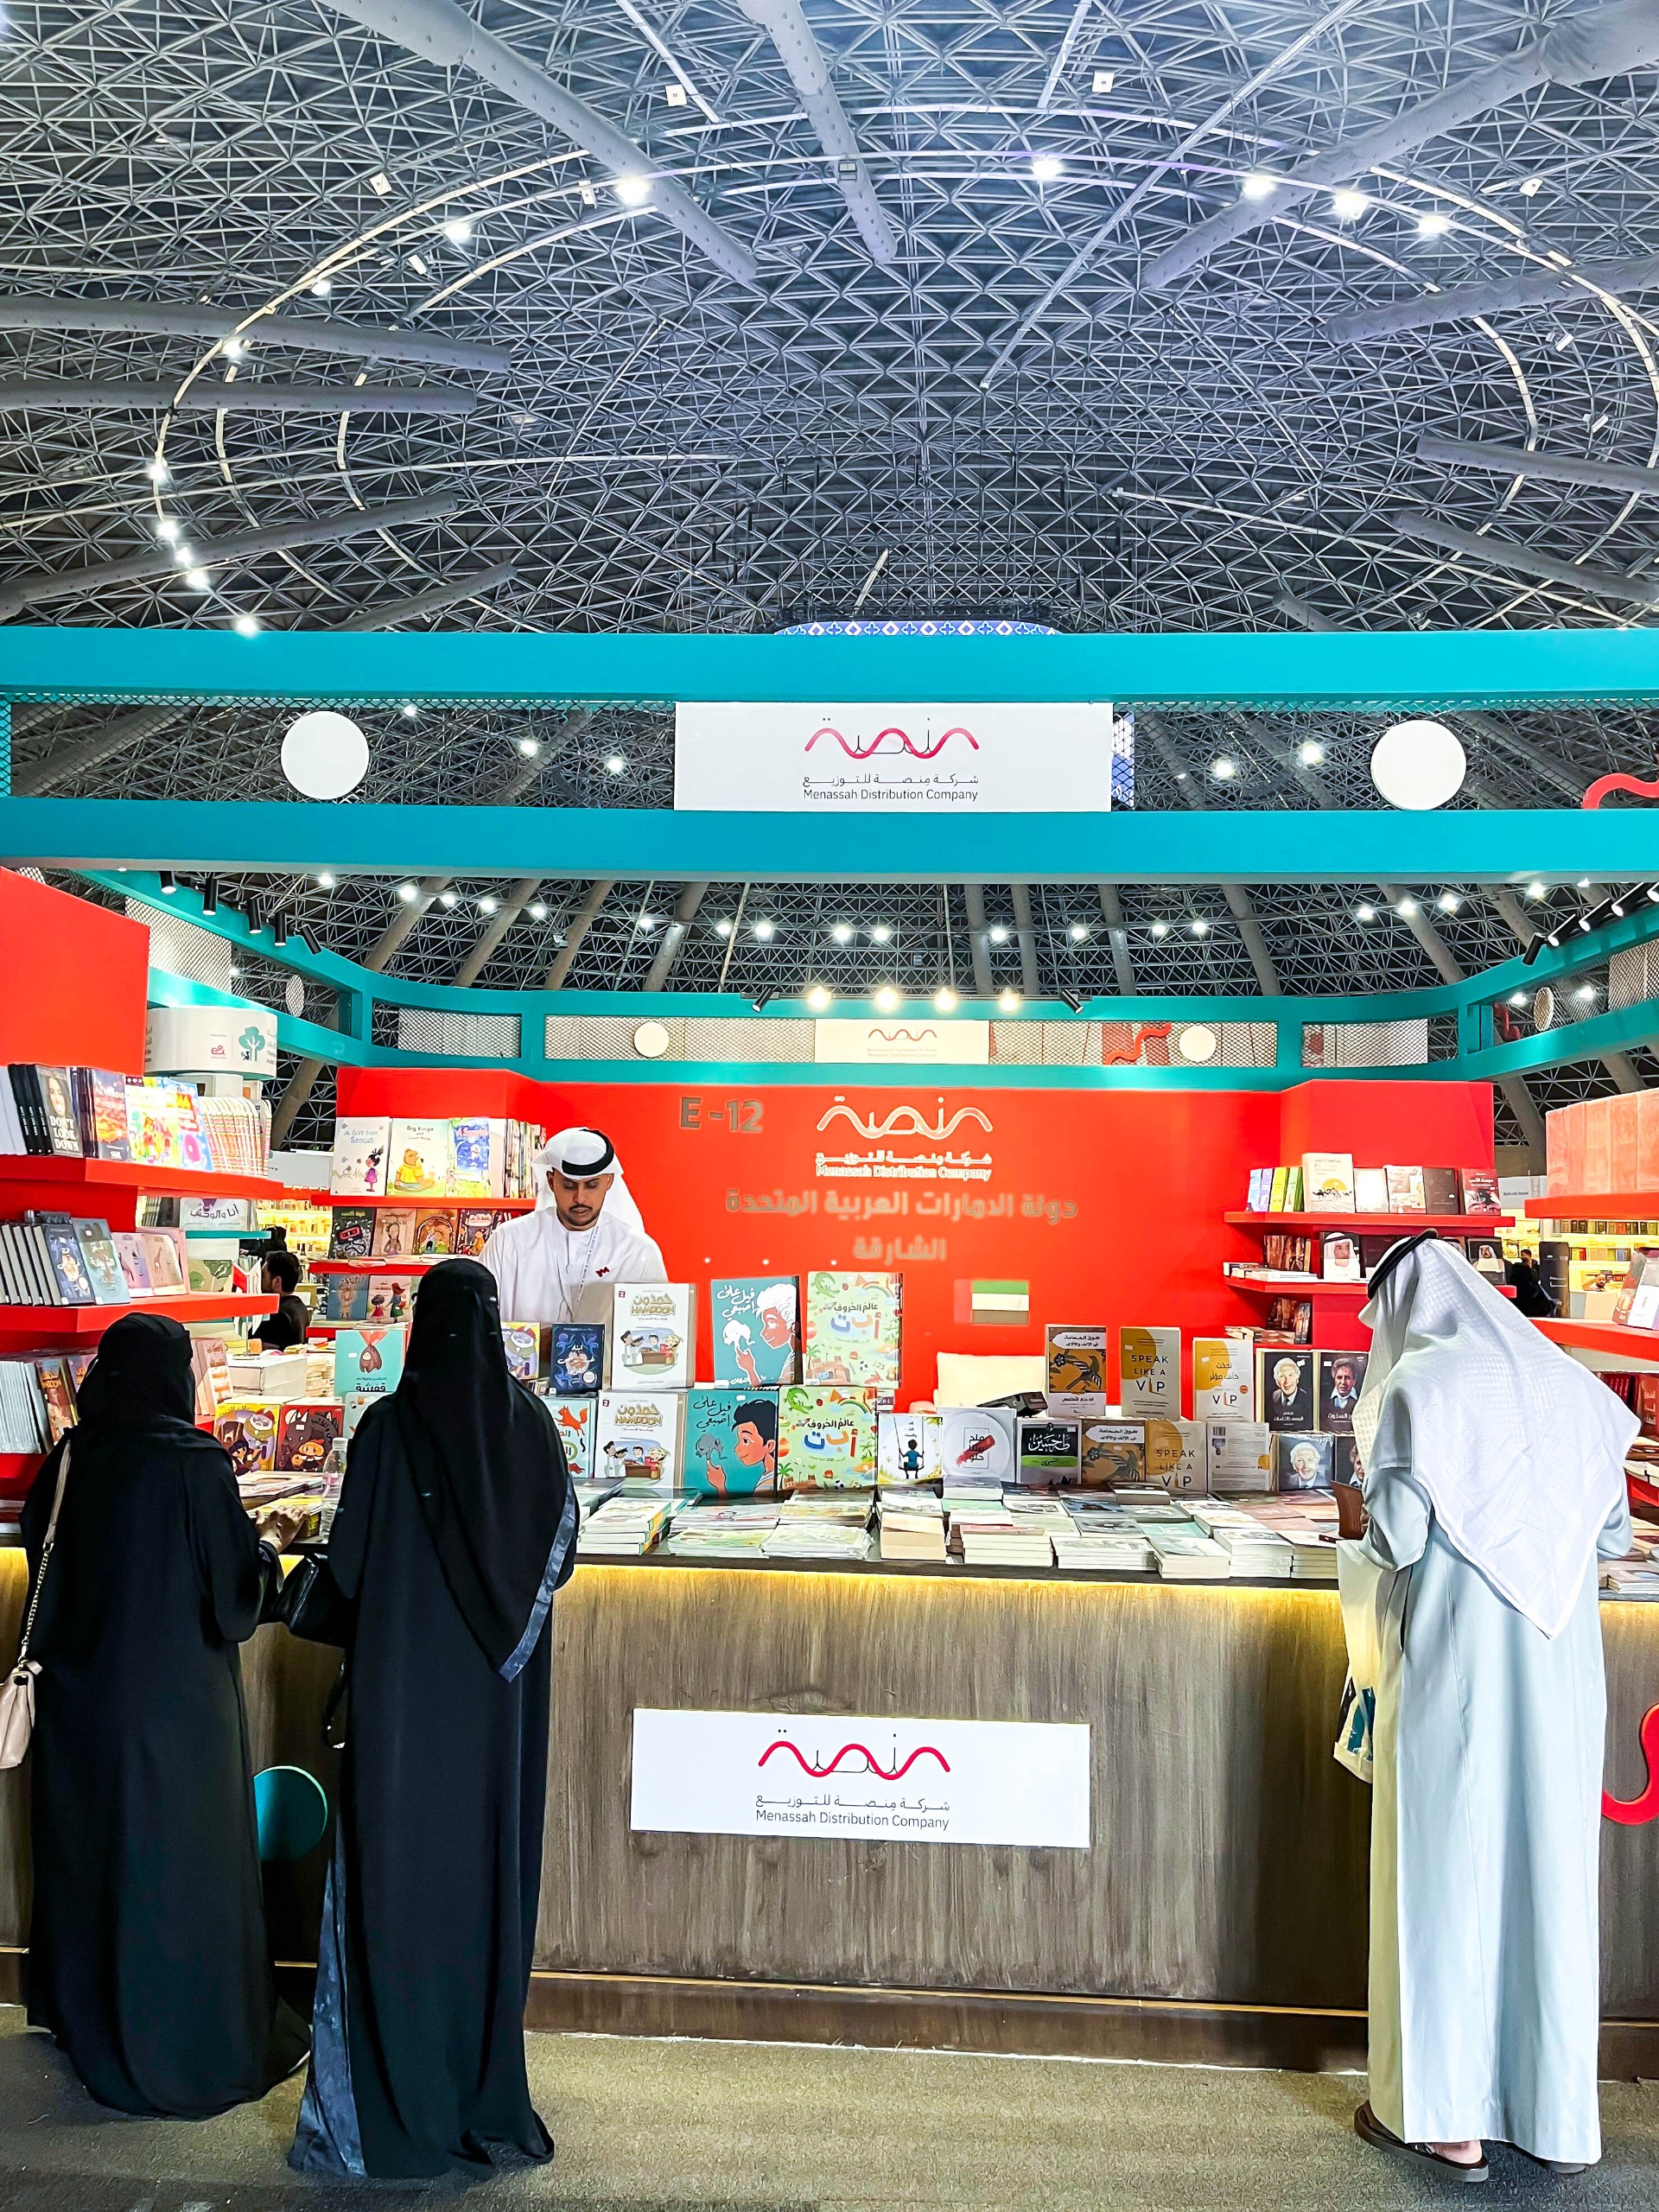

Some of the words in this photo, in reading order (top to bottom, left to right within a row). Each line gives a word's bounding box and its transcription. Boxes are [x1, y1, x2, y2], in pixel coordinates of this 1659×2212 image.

[803, 773, 871, 787] للتوزيع
[933, 773, 979, 786] شركة
[804, 789, 857, 799] Menassah
[861, 789, 923, 799] Distribution
[926, 790, 978, 802] Company
[680, 1096, 702, 1128] E
[49, 1116, 74, 1128] DON'T
[54, 1127, 76, 1140] LOOK
[54, 1138, 79, 1152] DOWN
[944, 1150, 992, 1166] شركة
[816, 1165, 872, 1177] Menassah
[874, 1166, 937, 1179] Distribution
[938, 1166, 992, 1181] Company
[726, 1189, 817, 1216] المتحدة
[824, 1191, 909, 1220] العربية
[1020, 1193, 1077, 1224] دولة
[853, 1236, 947, 1265] الشارقة
[731, 1287, 755, 1305] فيل
[632, 1305, 675, 1314] HAMDOON
[1131, 1355, 1168, 1363] SPEAK
[708, 1401, 731, 1416] فيل
[615, 1416, 662, 1426] HAMDOON
[756, 1794, 830, 1808] للتوزيع
[900, 1798, 950, 1813] شركة
[756, 1809, 816, 1822] Menassah
[820, 1812, 888, 1826] Distribution
[893, 1815, 949, 1831] Company
